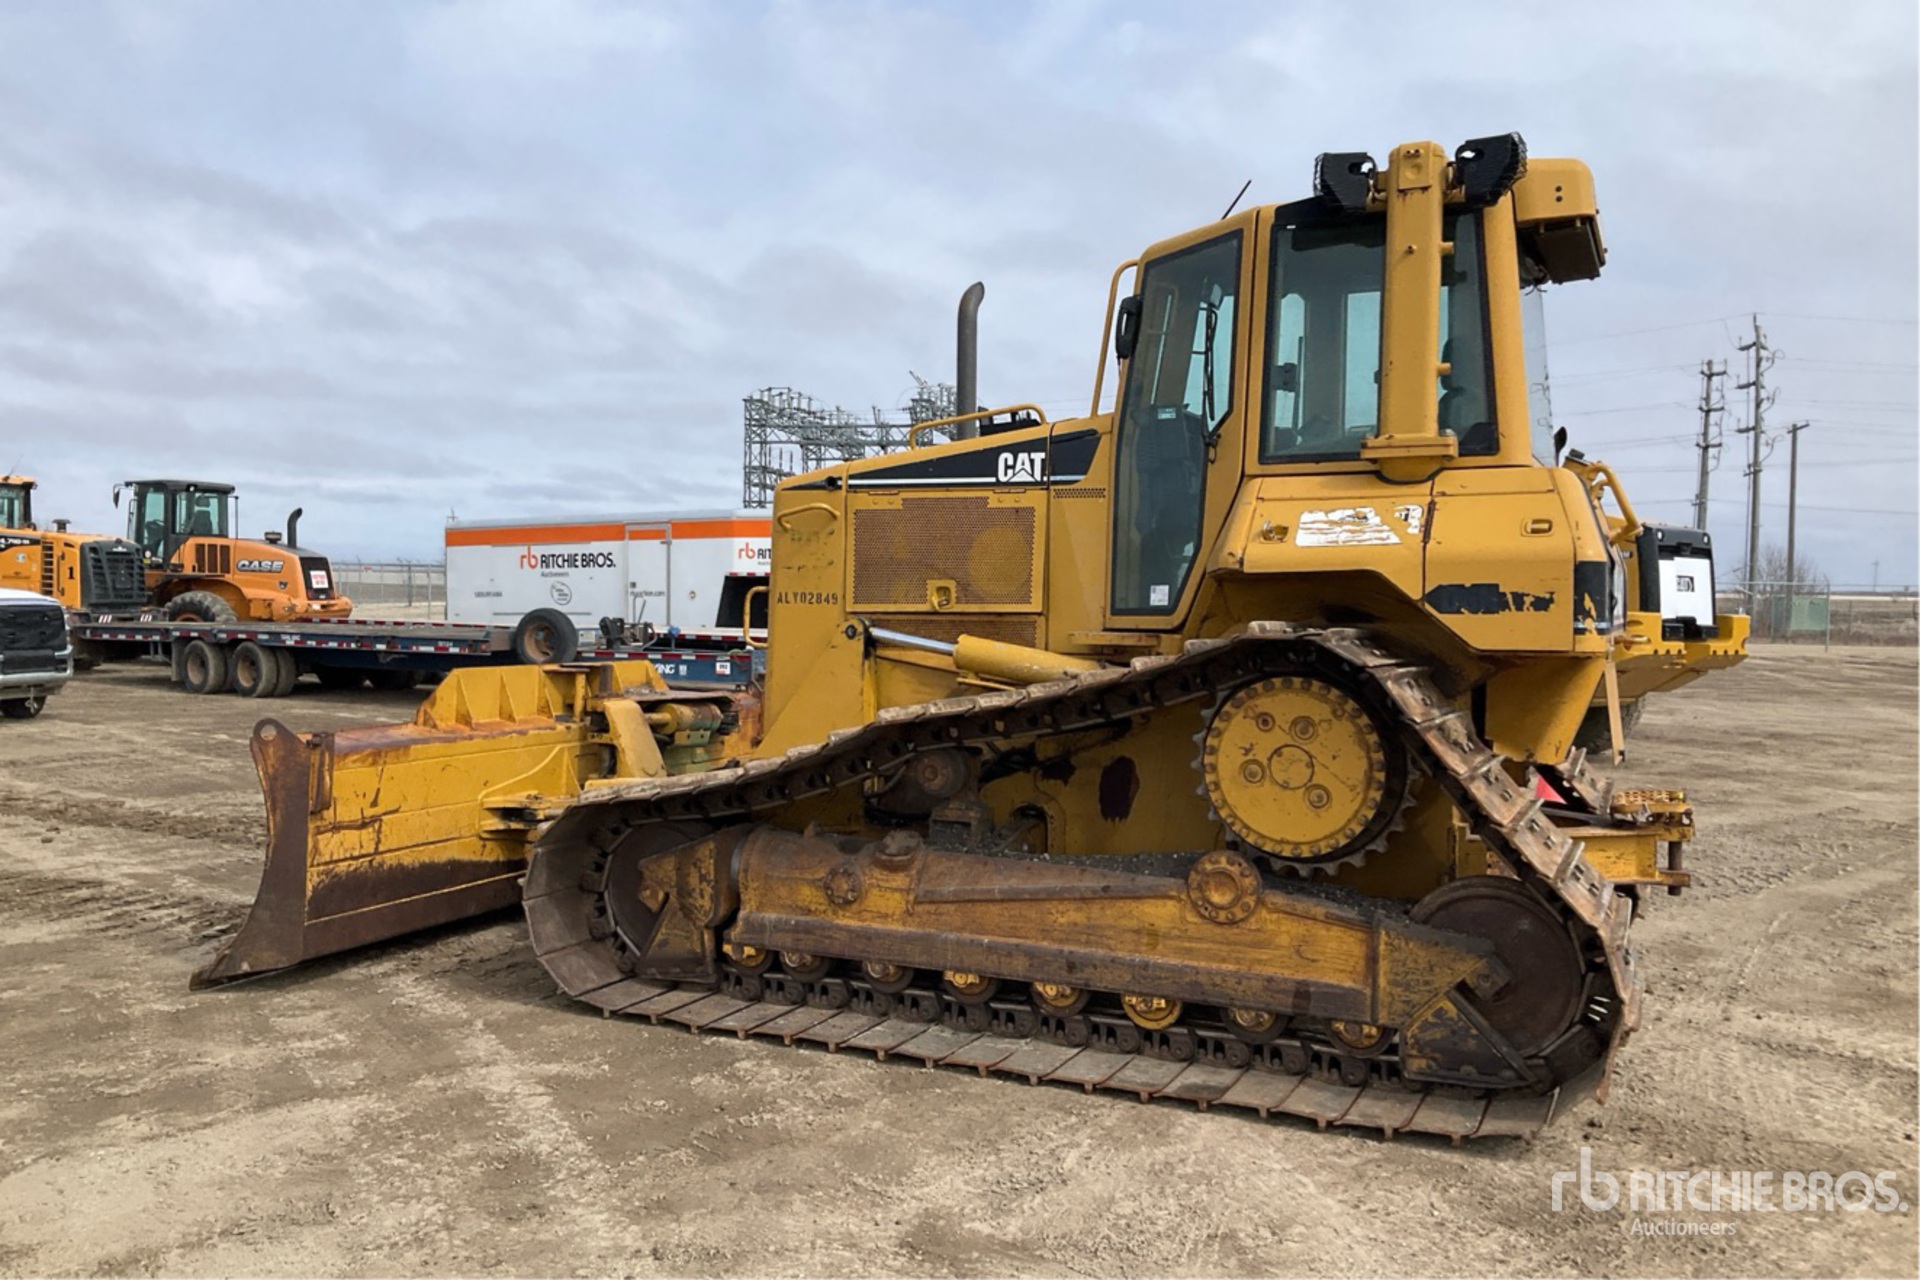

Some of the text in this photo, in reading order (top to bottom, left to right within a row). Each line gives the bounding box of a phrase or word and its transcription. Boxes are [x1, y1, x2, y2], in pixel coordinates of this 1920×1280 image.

[998, 452, 1046, 482] CAT
[519, 545, 616, 569] rb RITCHIE BROS.
[738, 542, 772, 559] rb RIT
[68, 566, 75, 579] 1
[237, 560, 284, 572] CASE
[655, 663, 675, 675] ING
